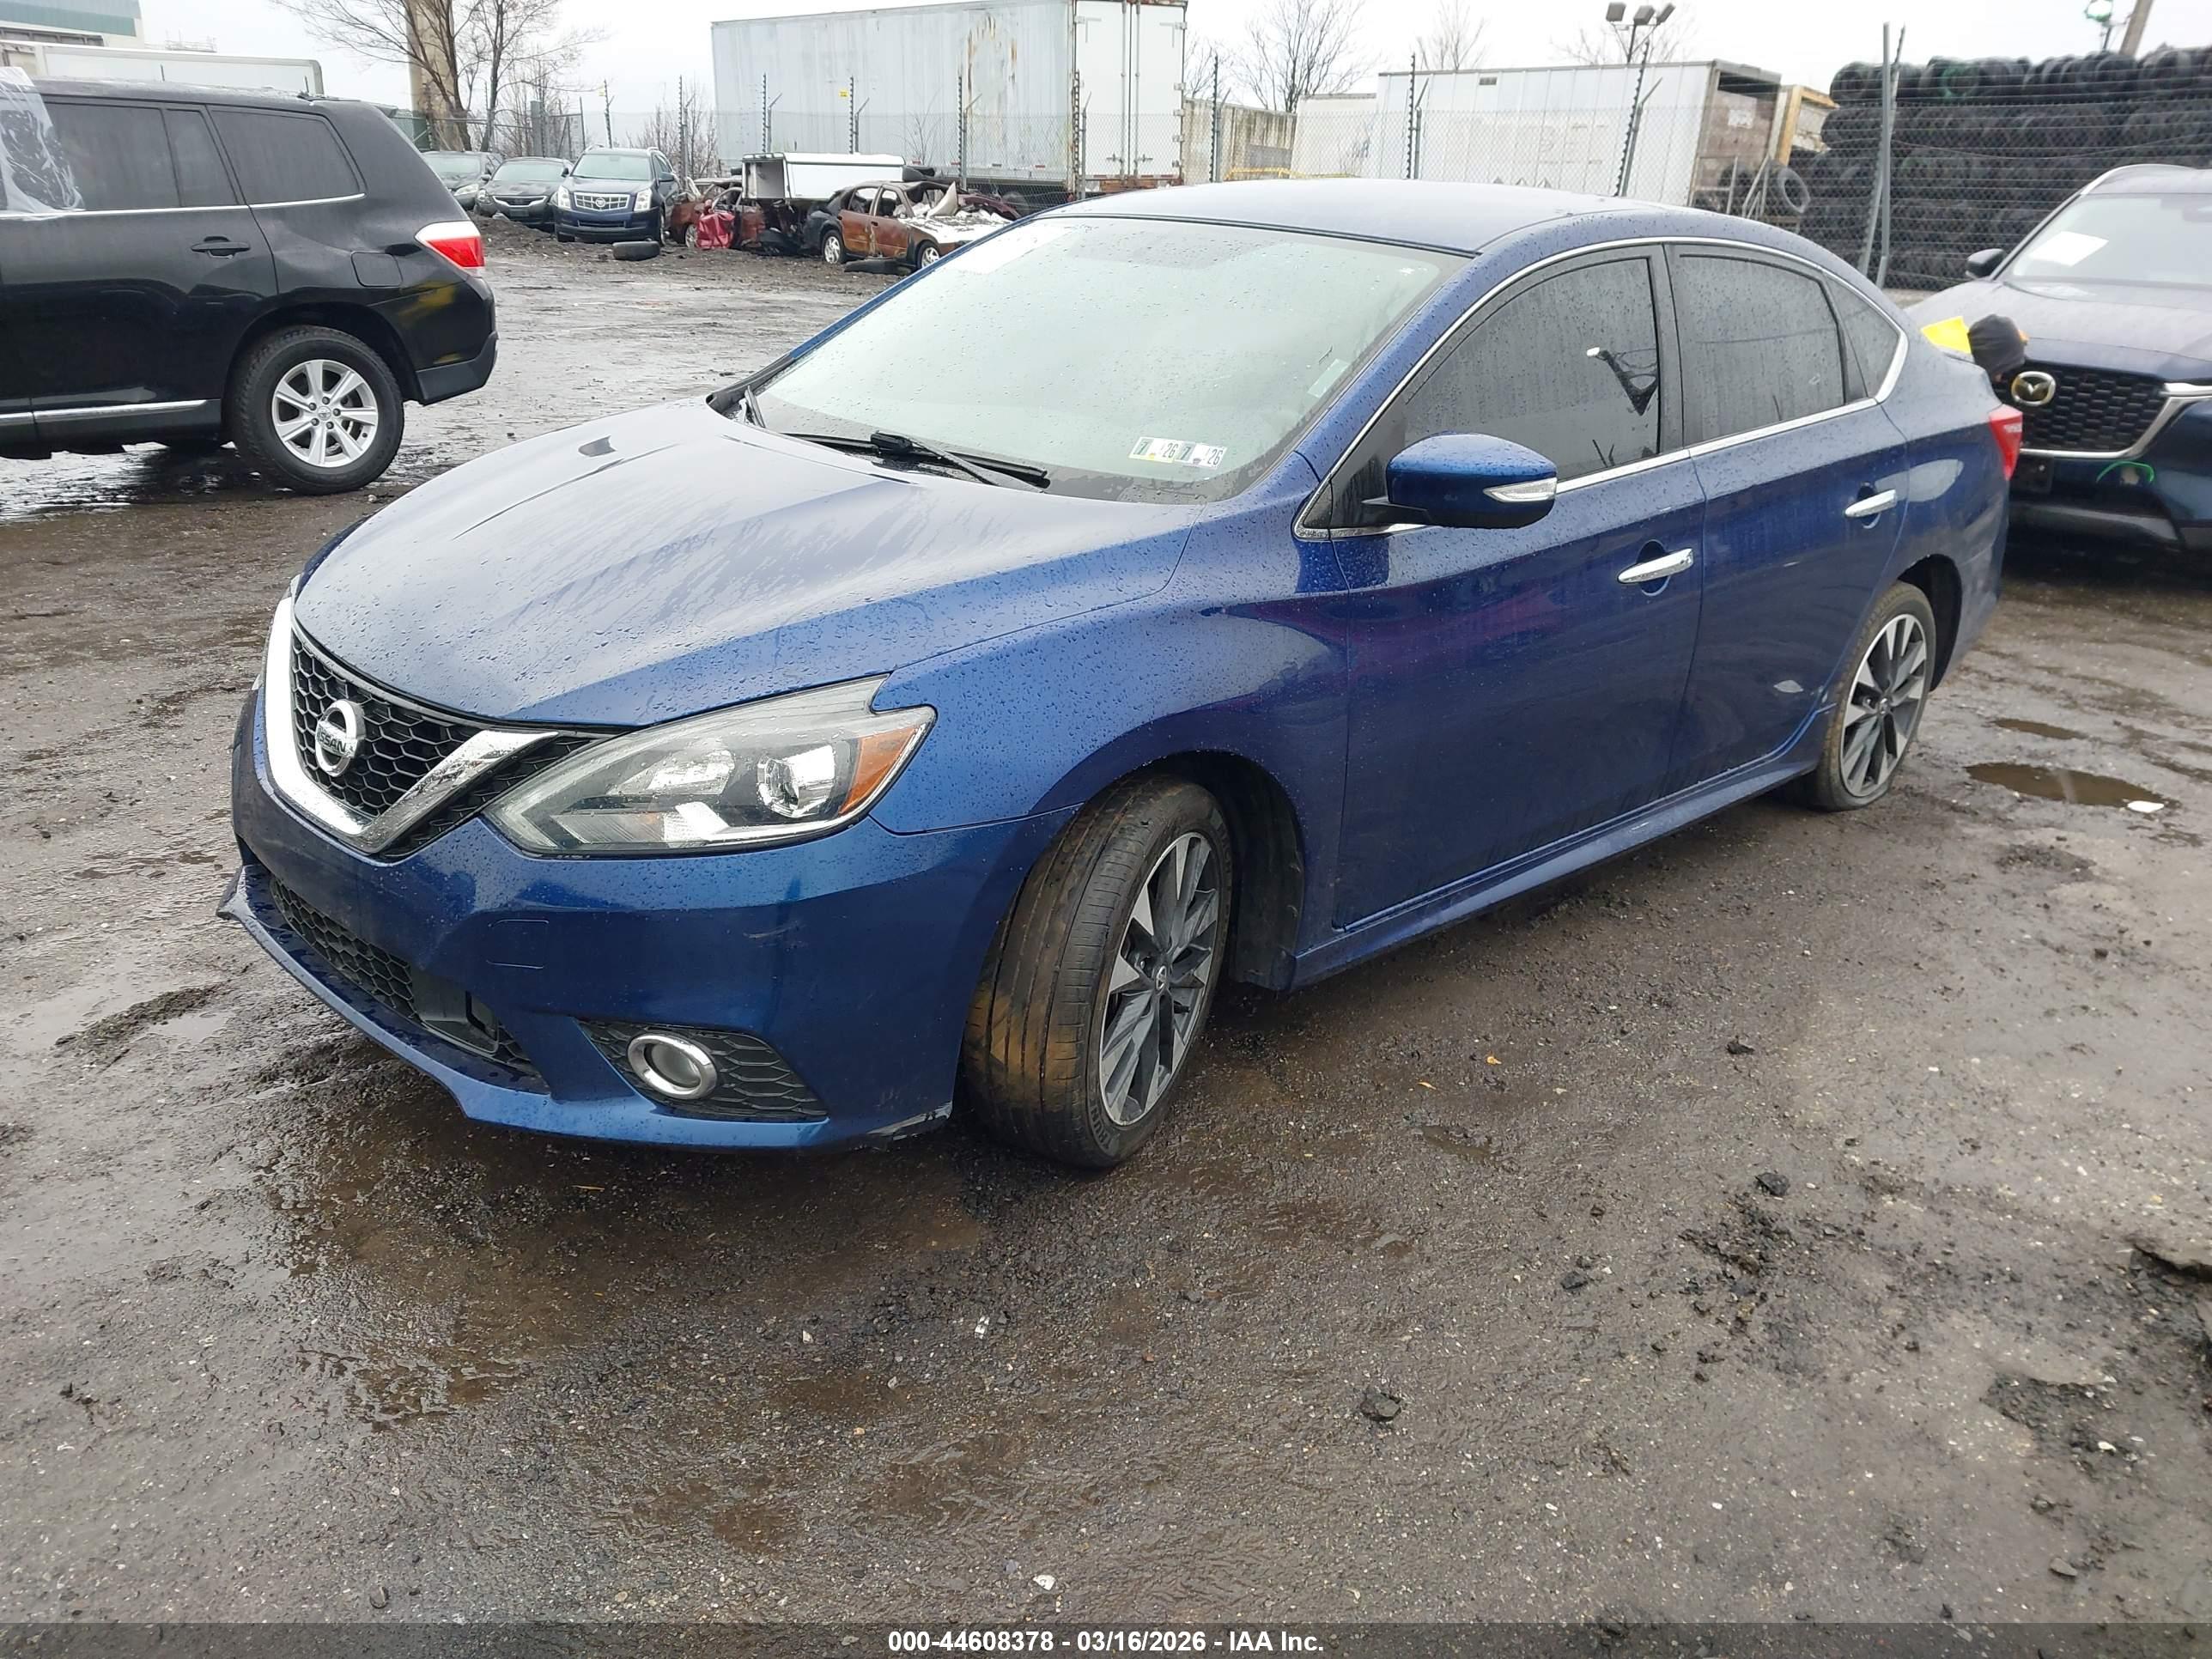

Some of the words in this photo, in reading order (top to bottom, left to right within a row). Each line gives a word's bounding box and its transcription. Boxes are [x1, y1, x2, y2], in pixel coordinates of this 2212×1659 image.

[1135, 441, 1149, 456] 7
[1162, 441, 1179, 459] 26
[1179, 446, 1193, 461] 7
[1206, 447, 1224, 465] 26
